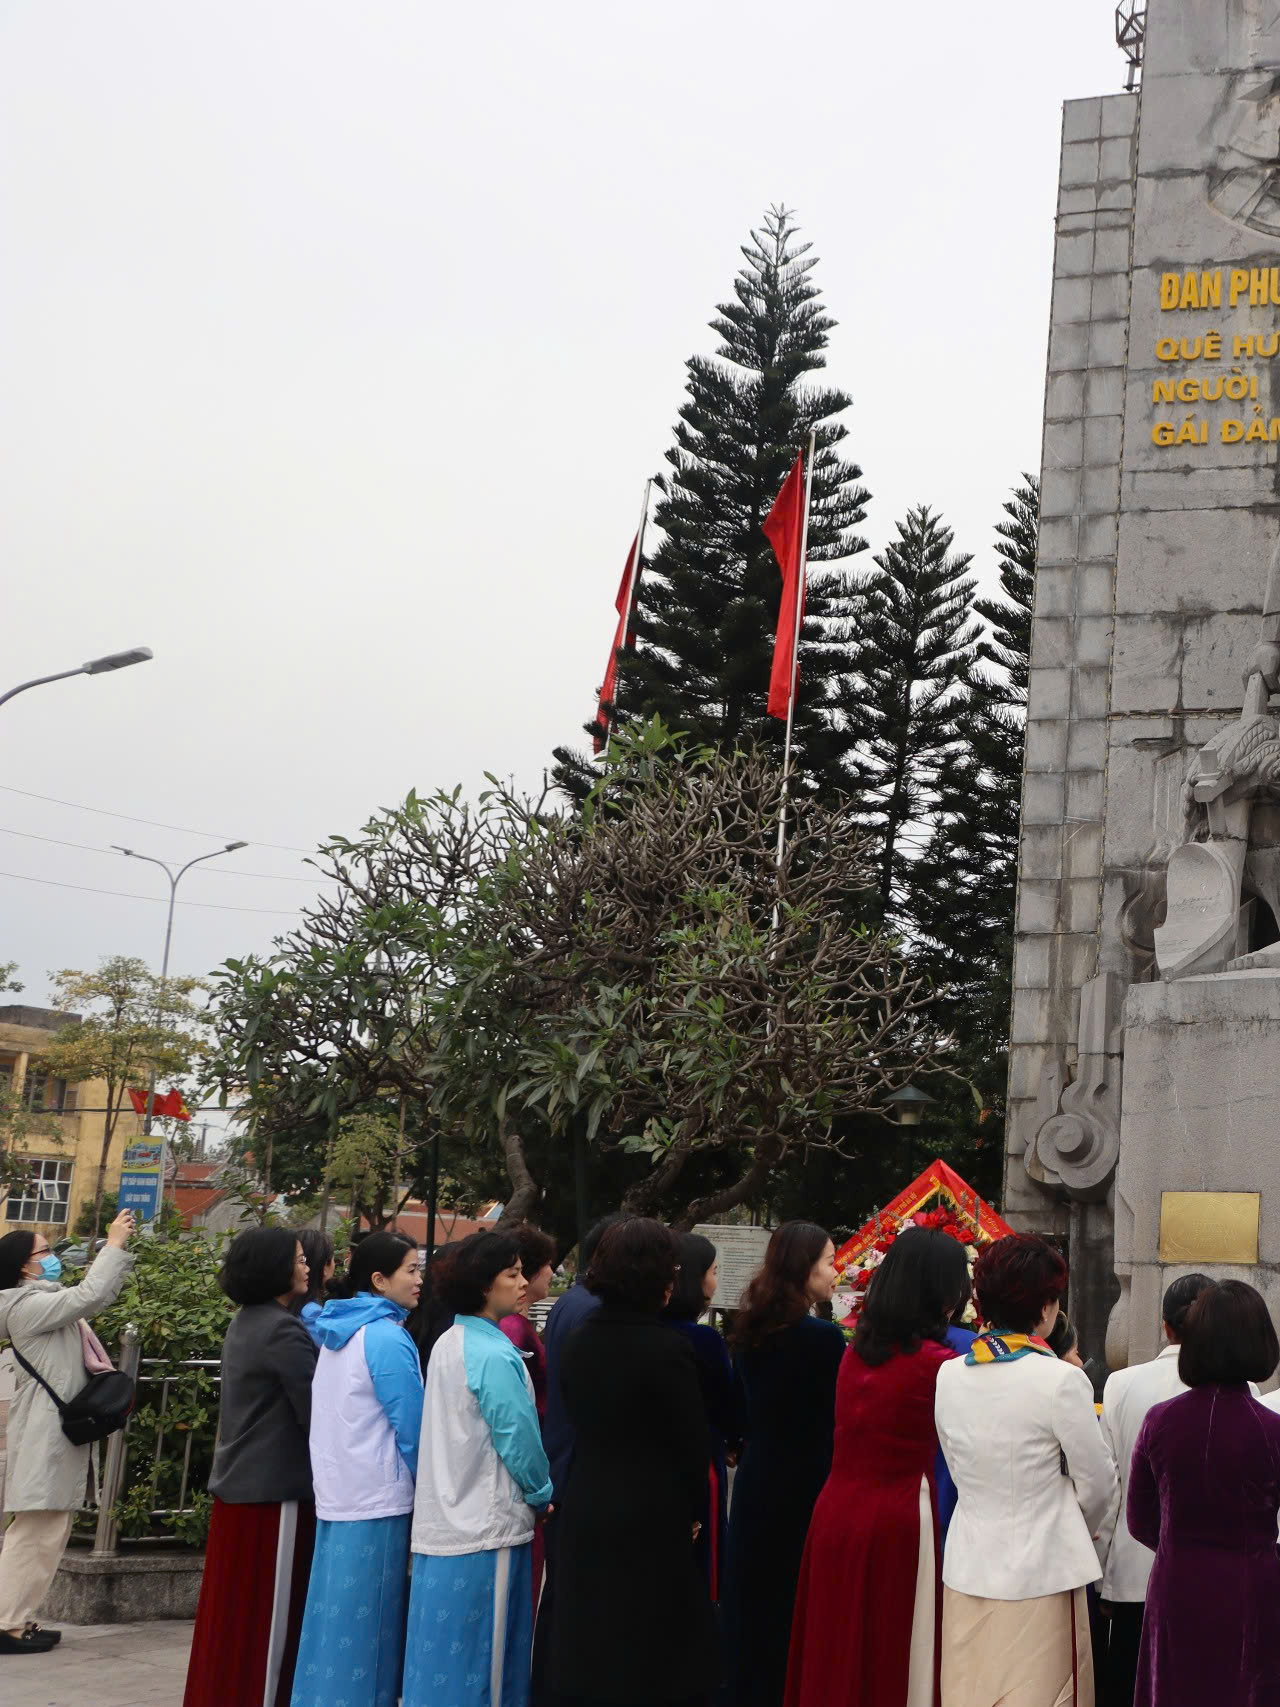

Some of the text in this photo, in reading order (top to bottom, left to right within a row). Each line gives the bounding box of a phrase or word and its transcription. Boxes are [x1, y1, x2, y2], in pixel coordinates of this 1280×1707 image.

[1160, 269, 1222, 311] ĐAN
[1155, 329, 1222, 361] QUÊ
[1152, 367, 1259, 404] NGƯỜI
[1152, 412, 1209, 447] GÁI
